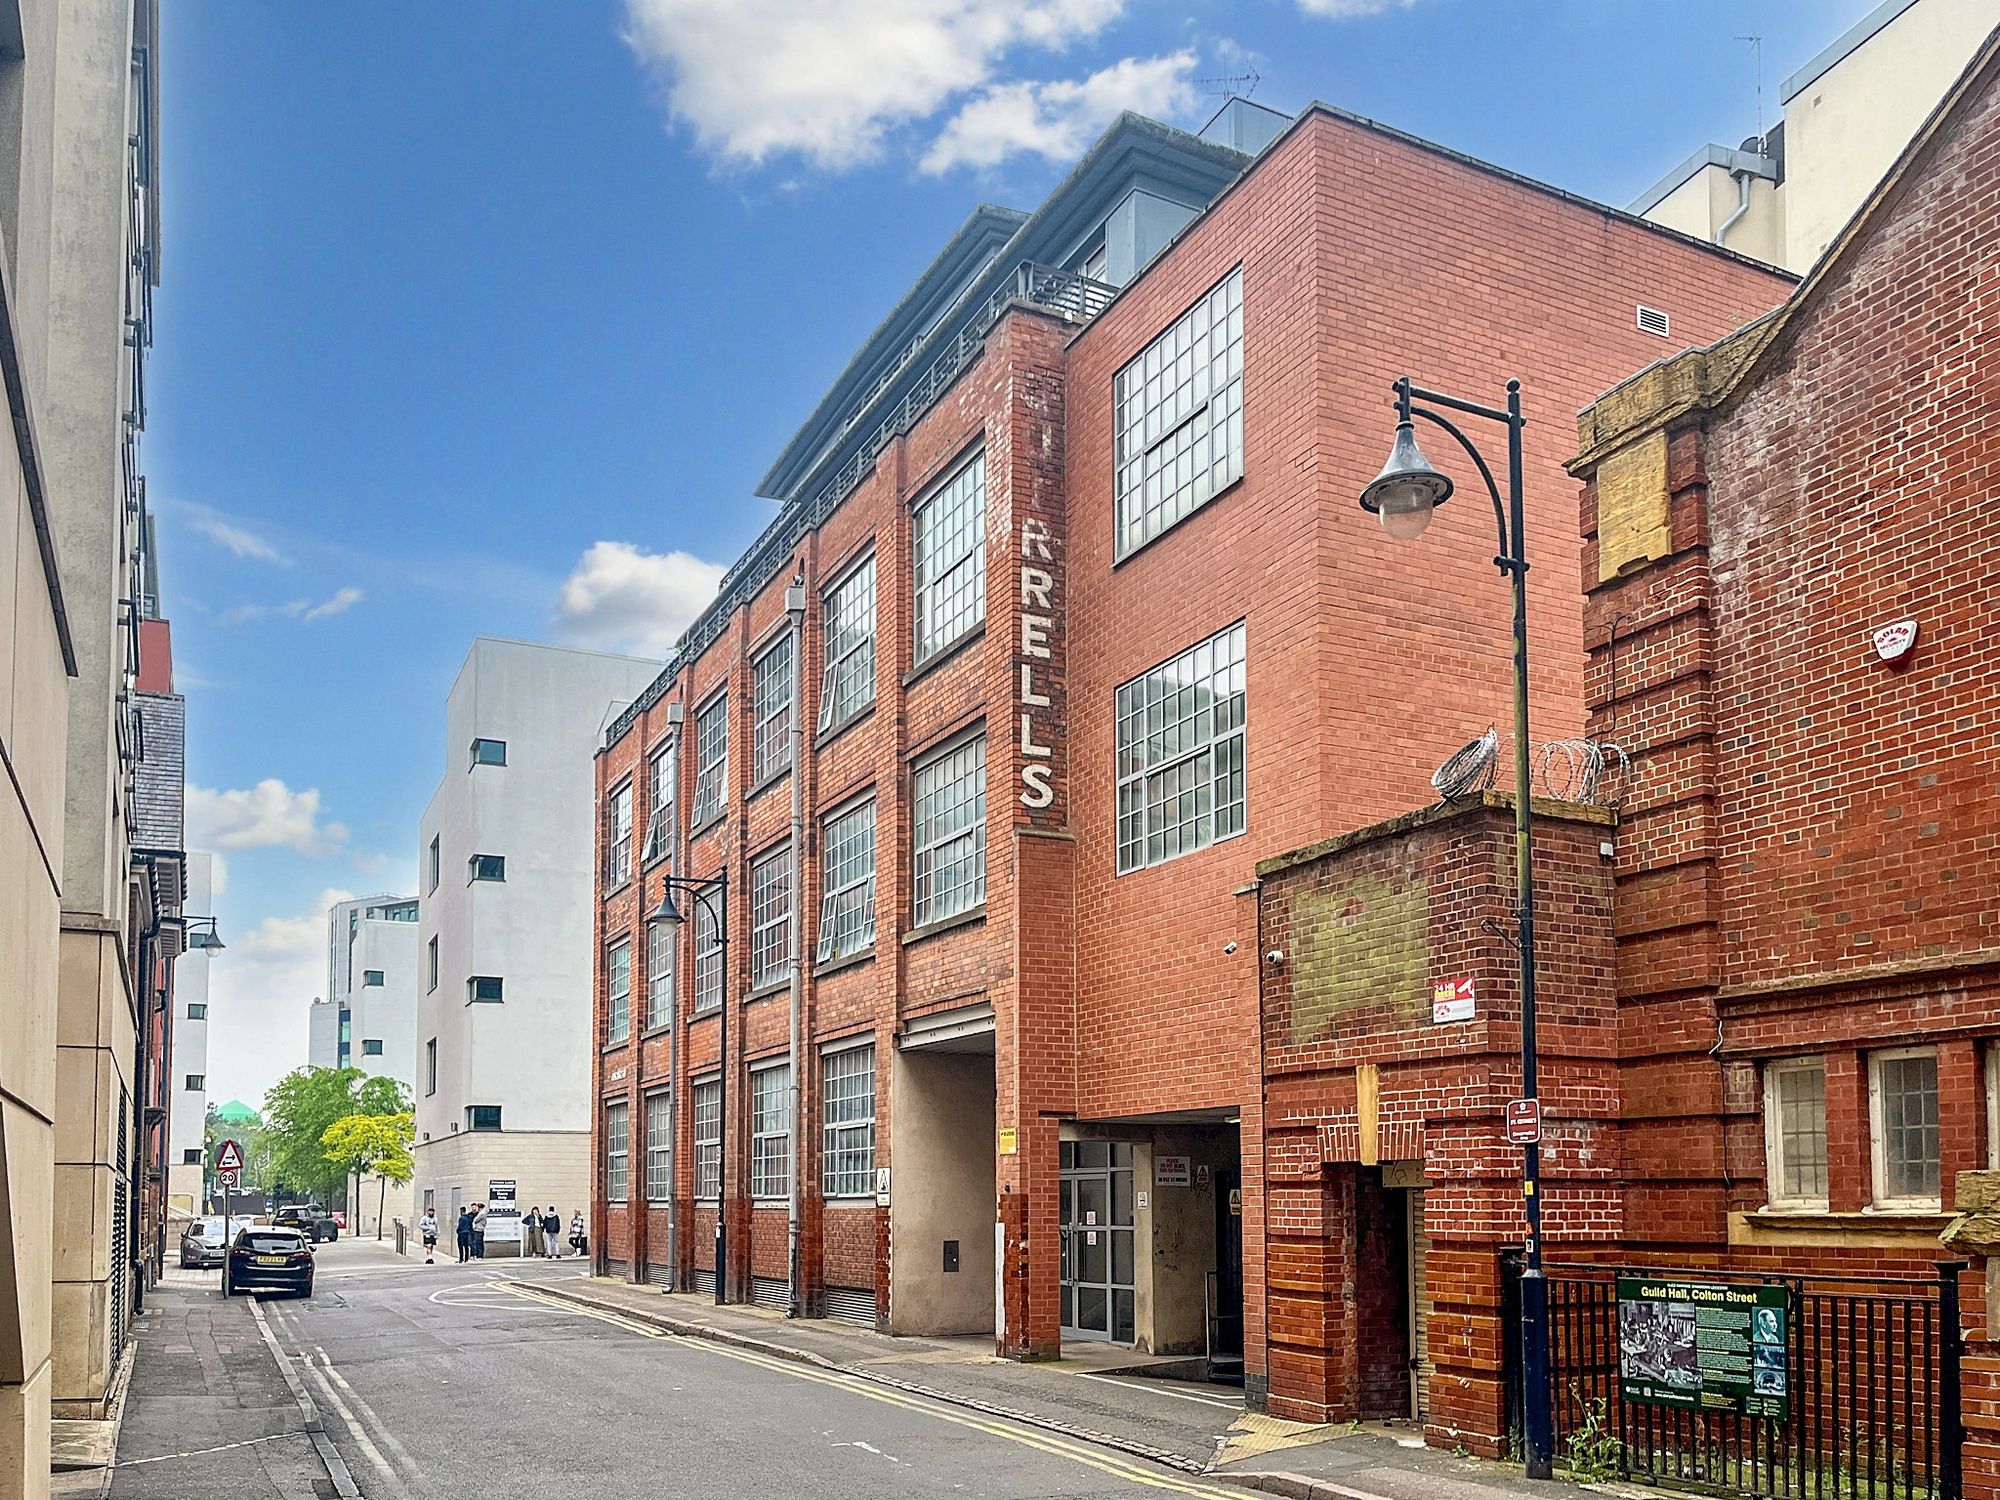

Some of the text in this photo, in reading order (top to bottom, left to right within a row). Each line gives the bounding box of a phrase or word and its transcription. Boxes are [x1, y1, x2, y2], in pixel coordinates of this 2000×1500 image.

[1641, 1286, 1667, 1298] Guild
[1668, 1288, 1690, 1301] Hall,
[1691, 1289, 1725, 1301] Colton
[1726, 1290, 1758, 1303] Street
